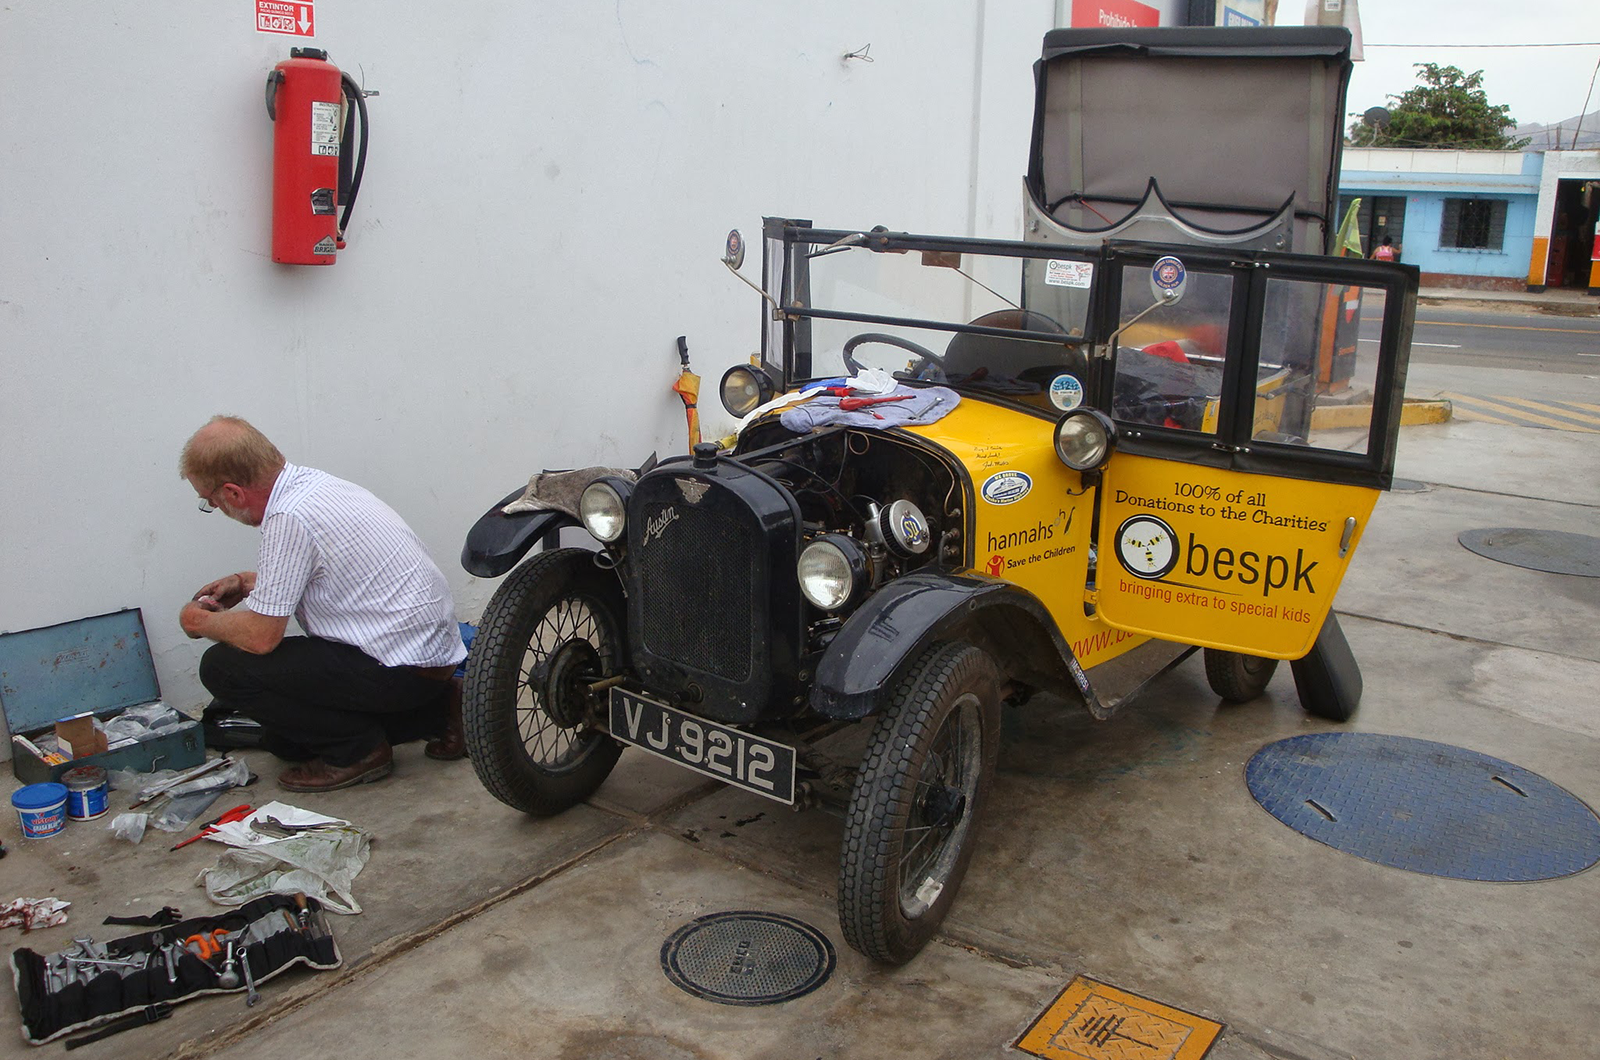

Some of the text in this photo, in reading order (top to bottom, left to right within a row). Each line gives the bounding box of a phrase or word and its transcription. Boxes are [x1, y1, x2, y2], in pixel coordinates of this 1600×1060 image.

[259, 1, 294, 12] EXTINTOR
[1115, 489, 1328, 532] Donations to the Charities
[1174, 482, 1266, 507] 100% of all
[642, 506, 680, 547] Austin
[987, 520, 1054, 553] hannahs
[1007, 545, 1076, 570] Save the Children
[1186, 532, 1319, 597] bespk
[1119, 579, 1311, 624] bringing extra to special kids
[623, 696, 775, 791] VJ 9212
